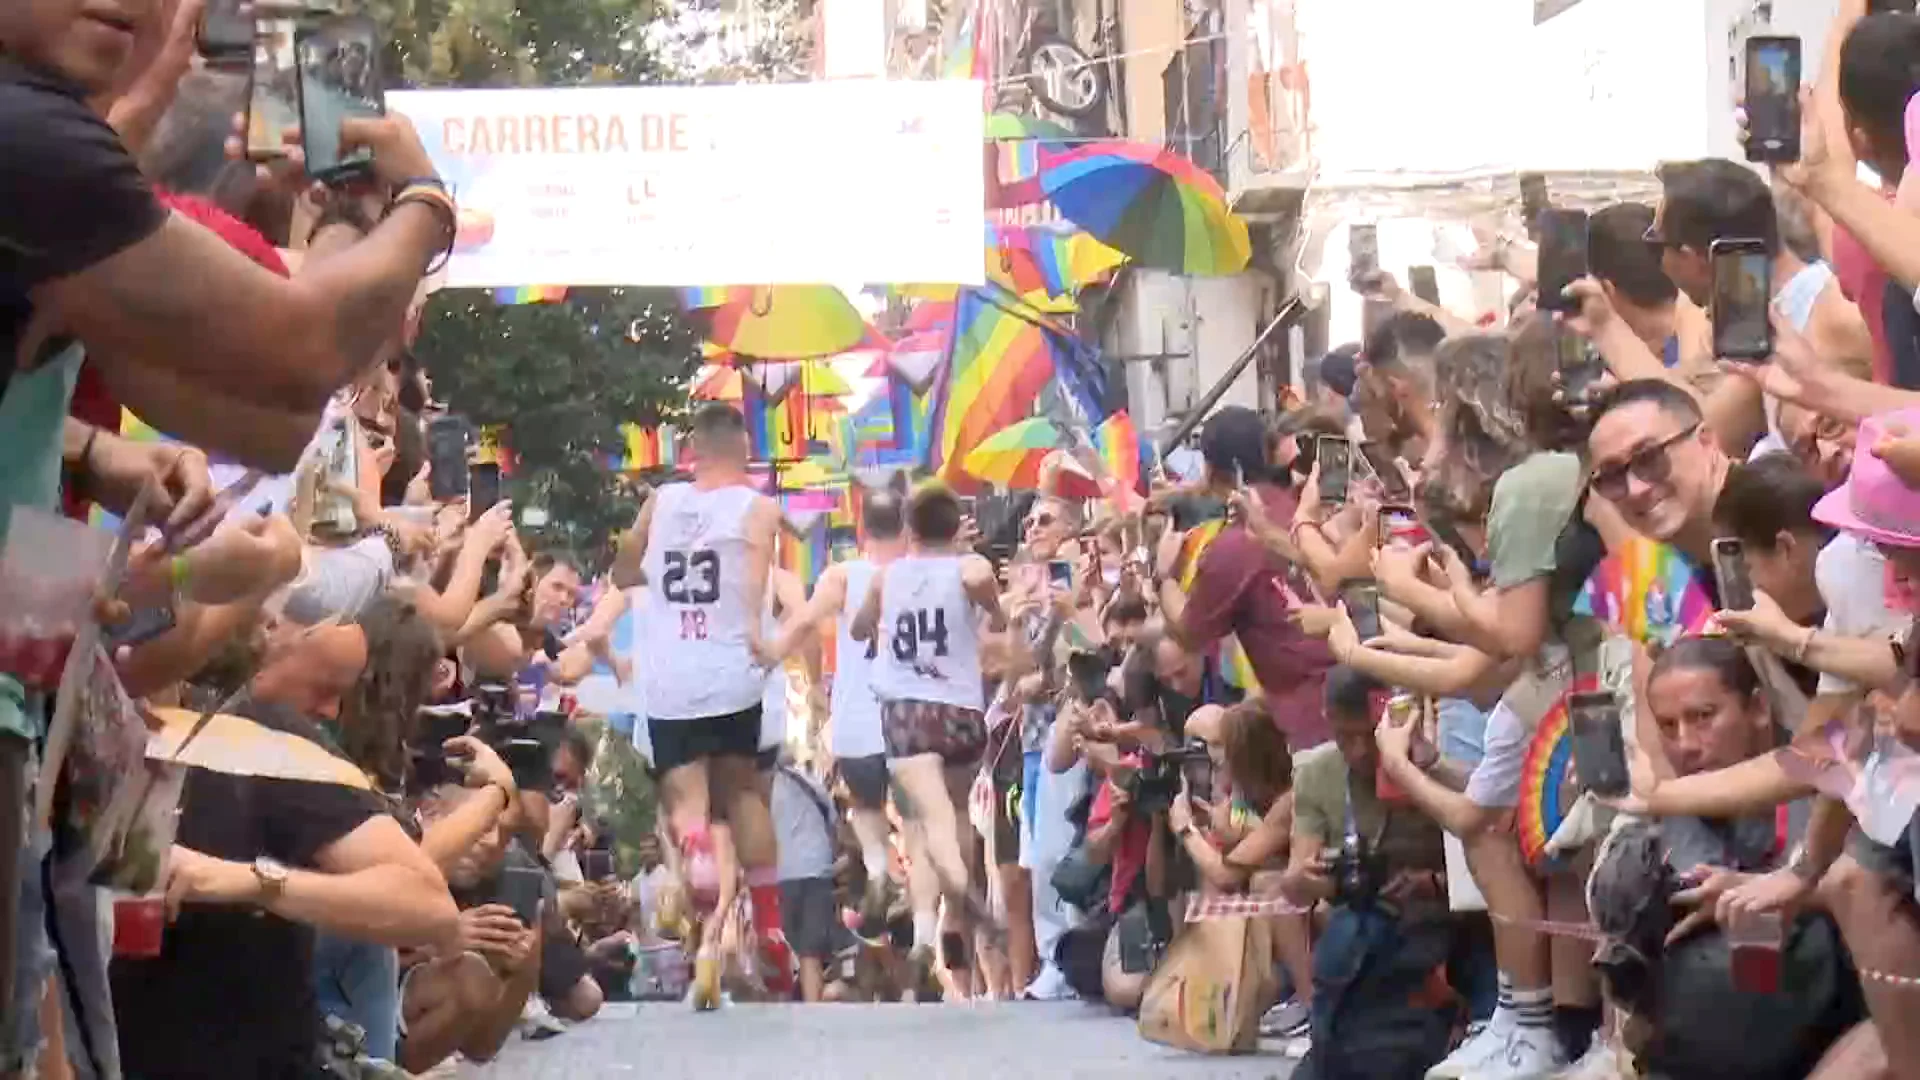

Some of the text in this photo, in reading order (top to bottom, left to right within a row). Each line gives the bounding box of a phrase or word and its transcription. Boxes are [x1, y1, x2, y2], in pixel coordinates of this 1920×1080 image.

[442, 113, 689, 155] CARRERA DE
[663, 550, 720, 604] 23
[892, 607, 949, 662] 84
